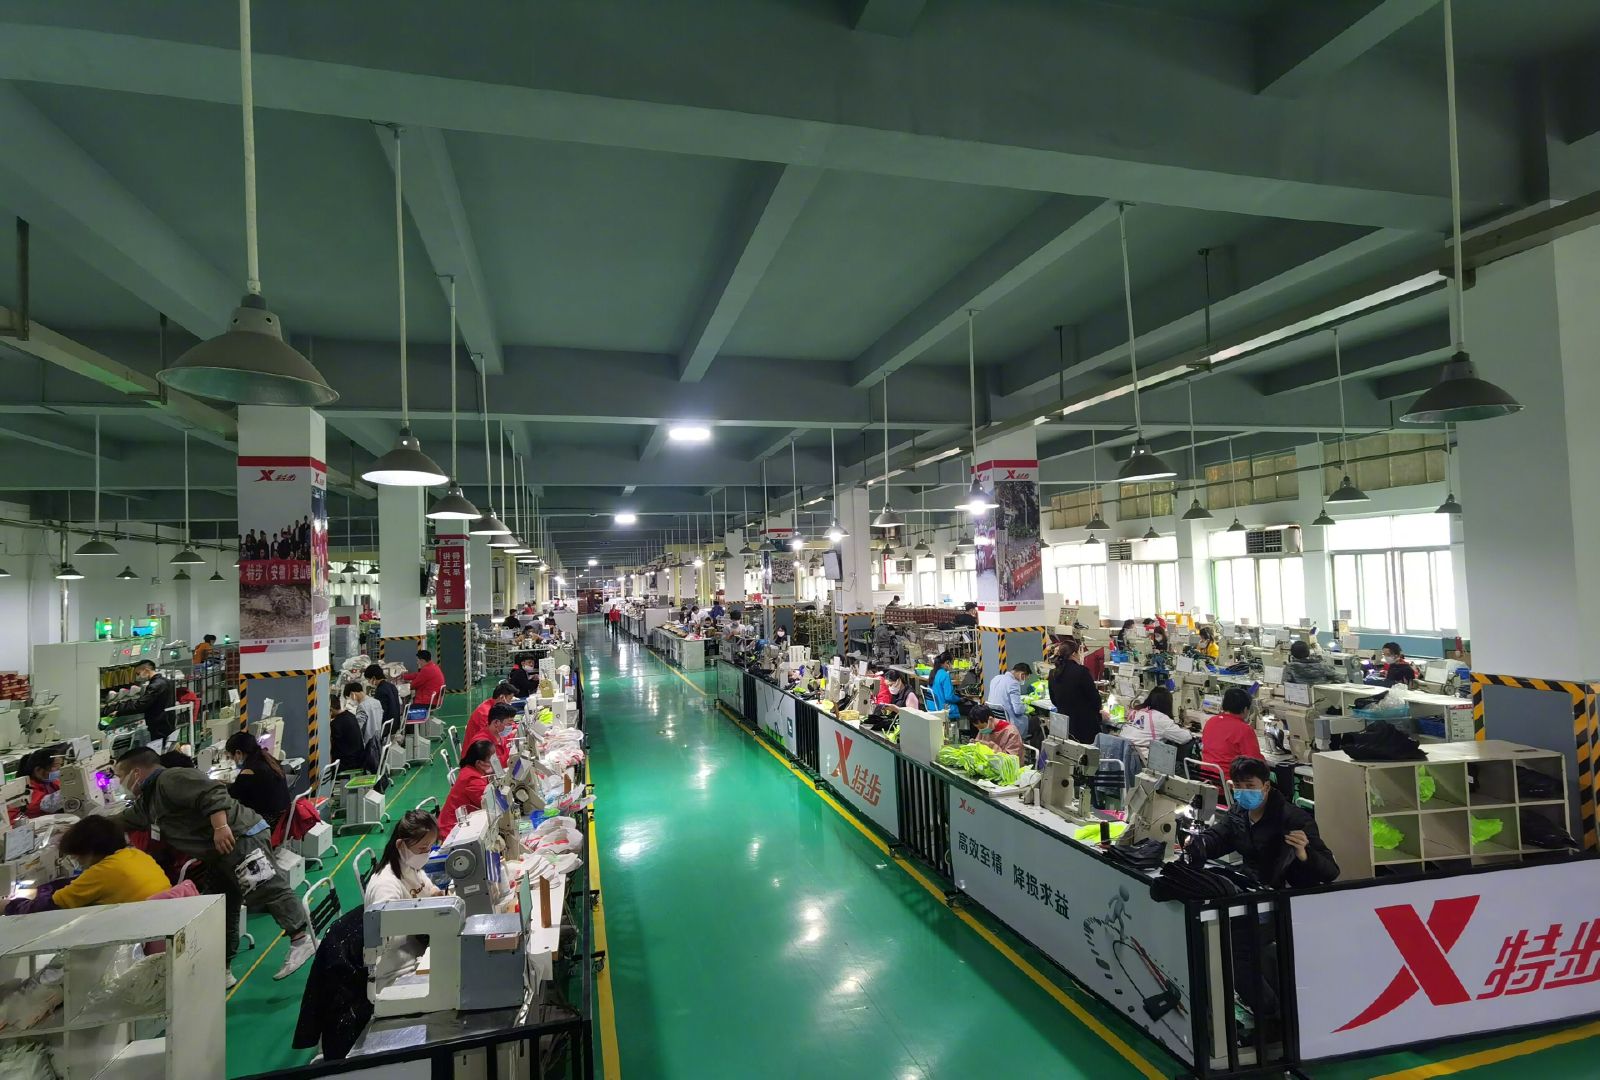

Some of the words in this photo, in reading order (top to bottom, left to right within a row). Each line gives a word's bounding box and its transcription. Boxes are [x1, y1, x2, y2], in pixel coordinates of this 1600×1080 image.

[850, 764, 882, 807] 特步
[958, 831, 1003, 877] 高效至精
[1013, 863, 1070, 920] 降损求益
